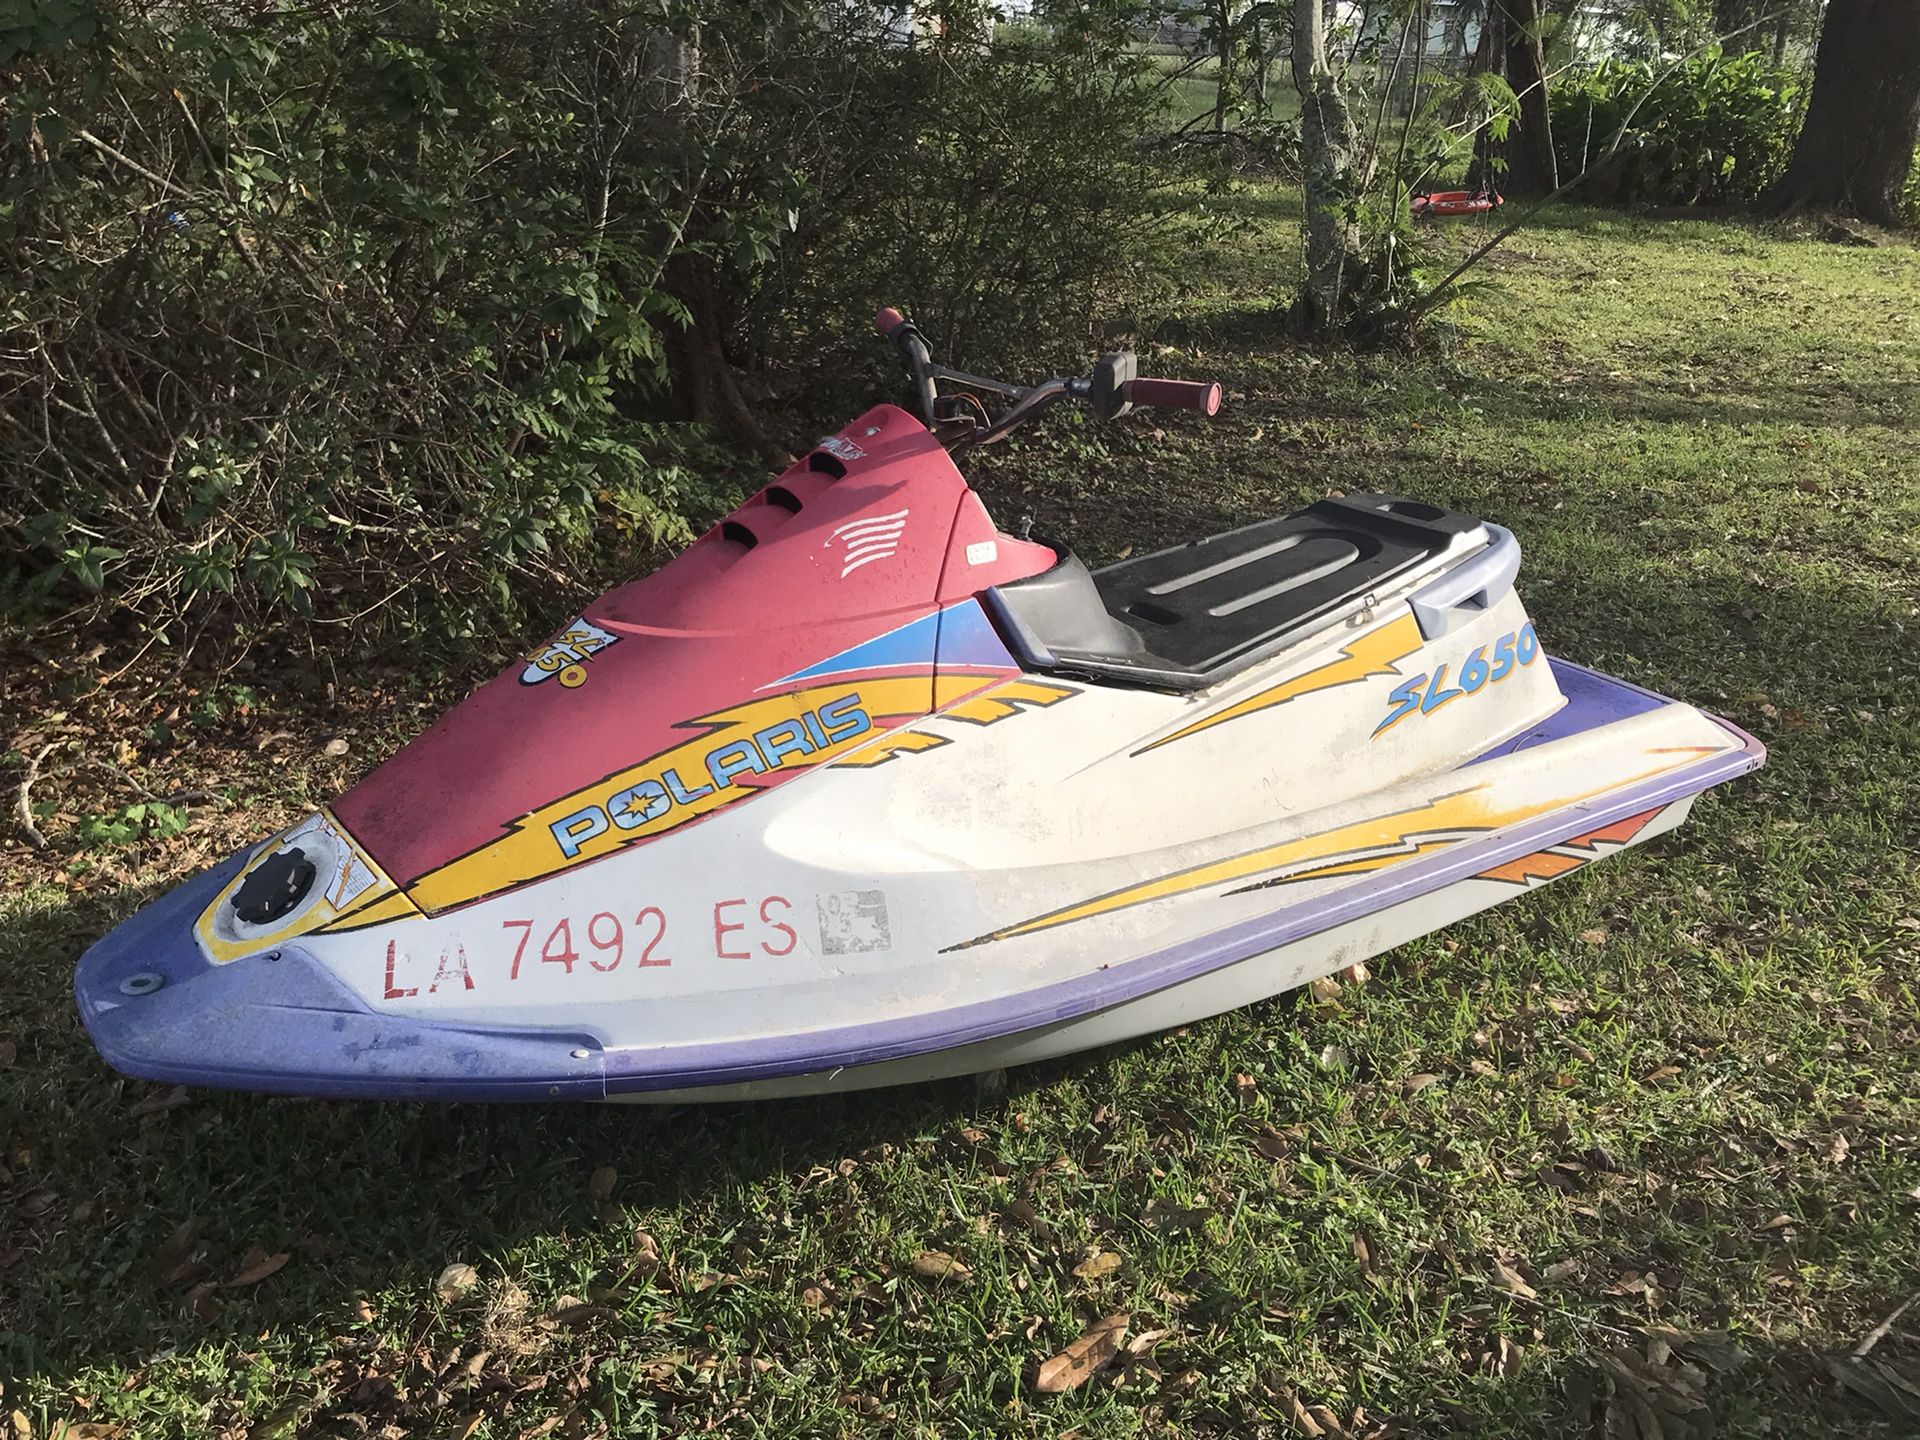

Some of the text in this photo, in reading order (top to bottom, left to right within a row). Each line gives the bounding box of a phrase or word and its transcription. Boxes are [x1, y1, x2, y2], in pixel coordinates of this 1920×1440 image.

[548, 692, 873, 860] POLARIS
[384, 933, 475, 999] LA
[502, 906, 672, 981] 7492
[713, 895, 798, 960] ES
